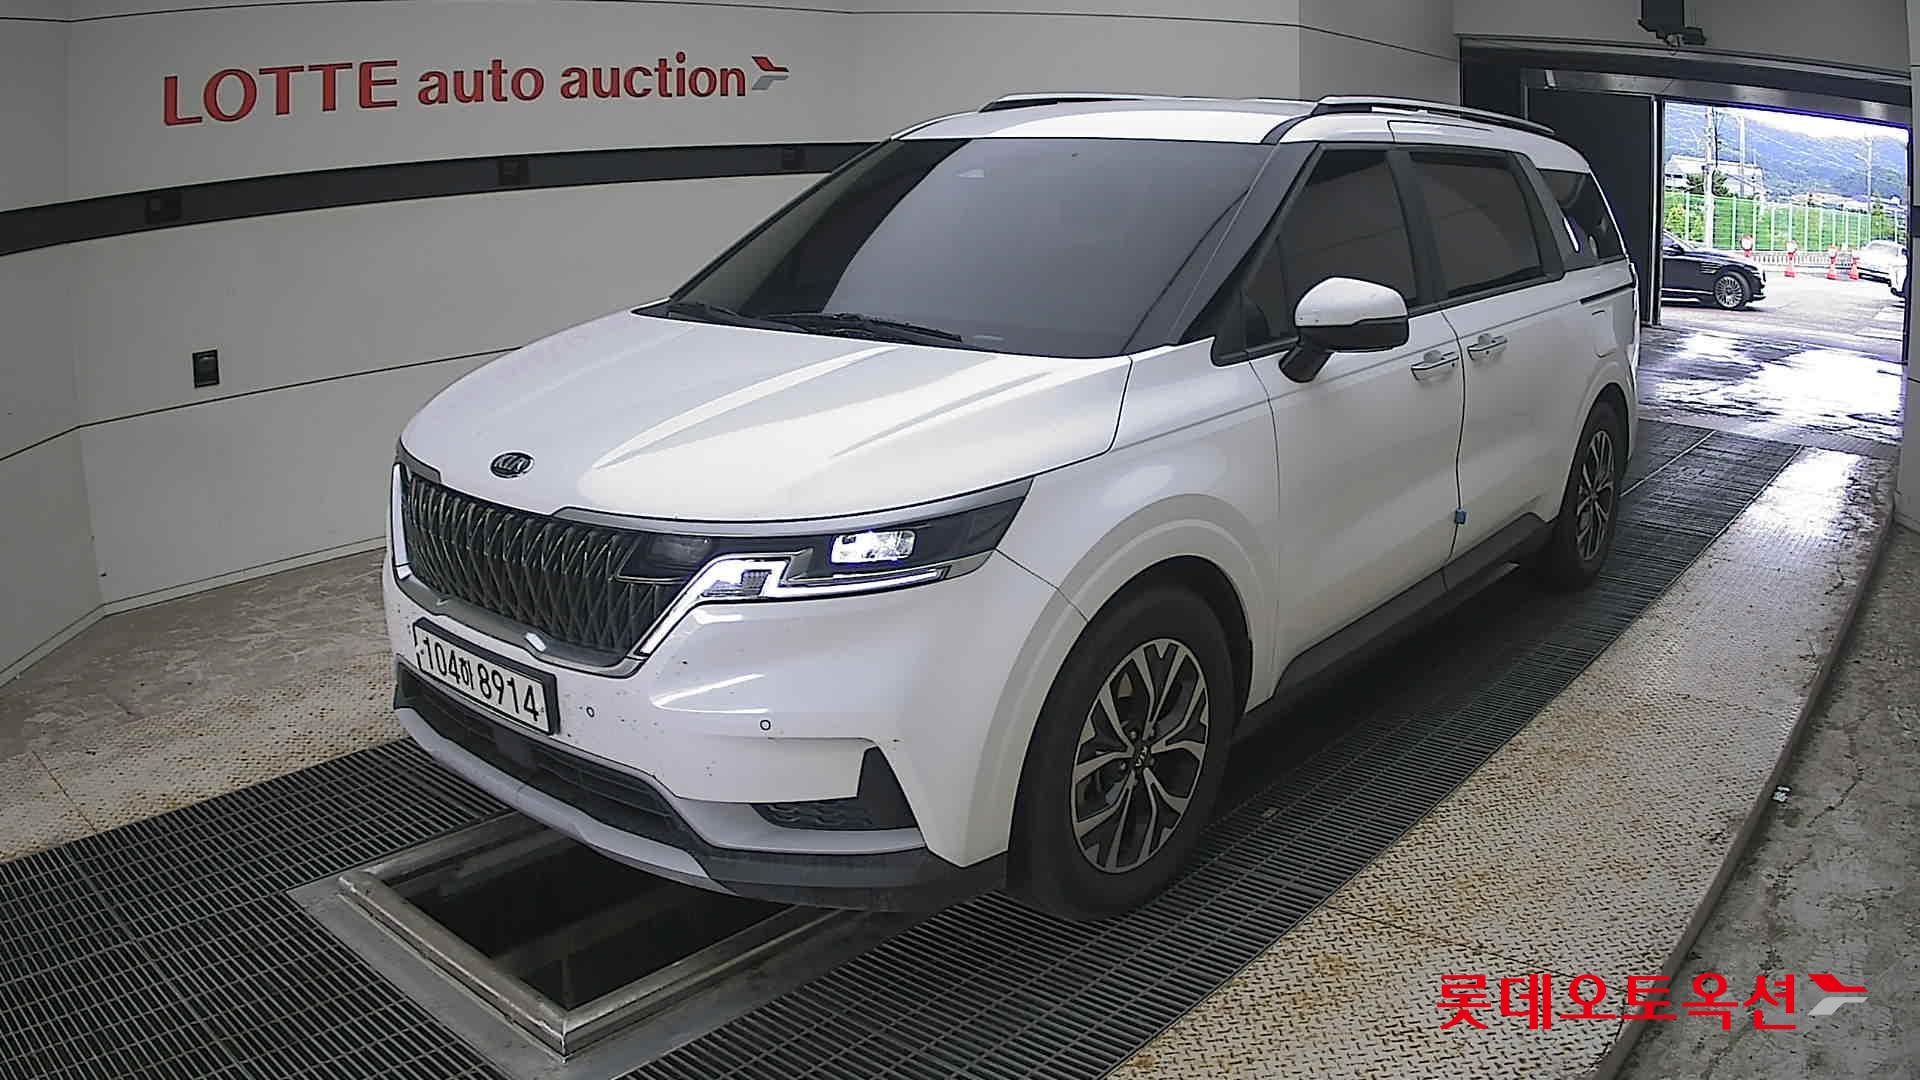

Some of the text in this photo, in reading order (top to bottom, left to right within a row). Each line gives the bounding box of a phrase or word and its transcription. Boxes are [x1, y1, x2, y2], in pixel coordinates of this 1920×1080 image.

[164, 51, 746, 126] LOTTE auto auction
[477, 663, 539, 722] 8914
